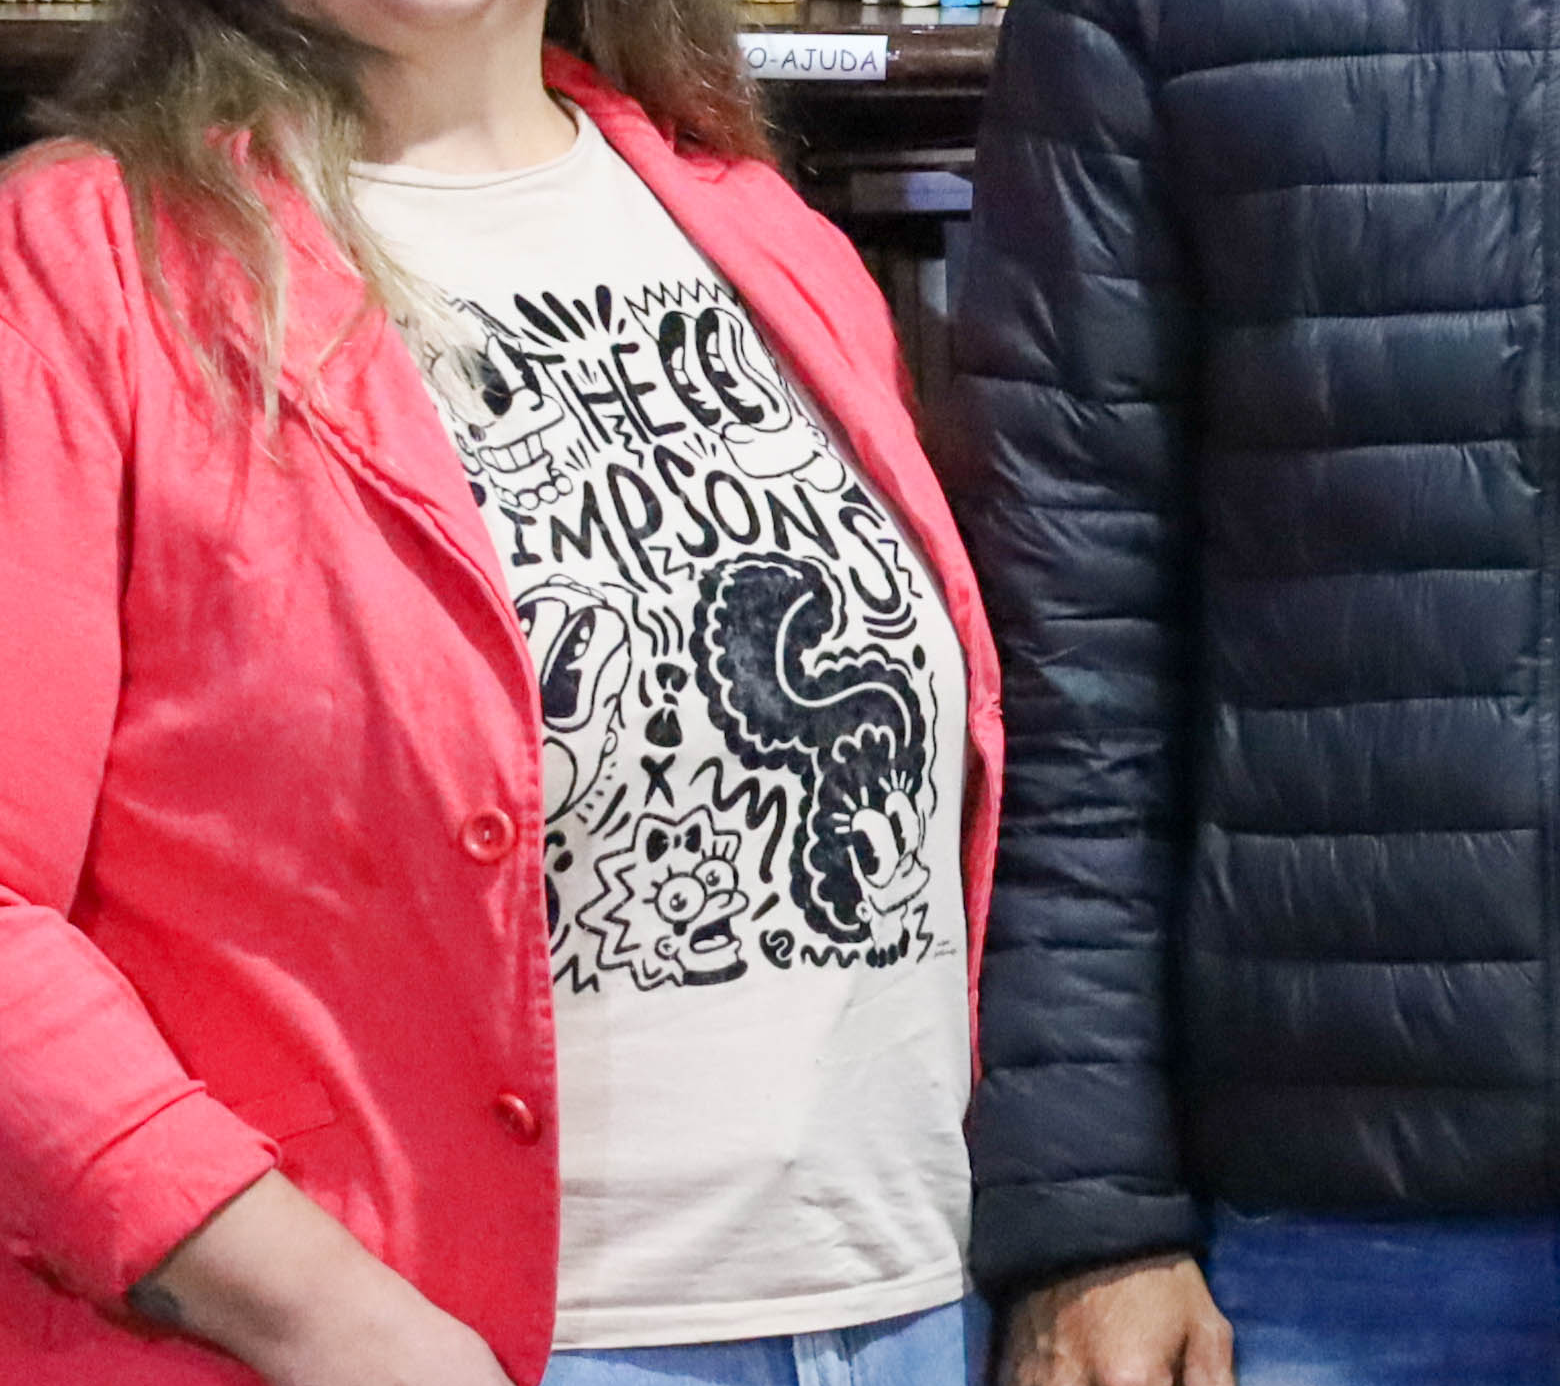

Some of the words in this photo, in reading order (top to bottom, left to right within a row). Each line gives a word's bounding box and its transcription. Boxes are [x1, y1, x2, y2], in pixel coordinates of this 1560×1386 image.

[743, 47, 877, 72] O-AJUDA
[524, 339, 686, 449] THE
[508, 449, 904, 615] IMPSONS
